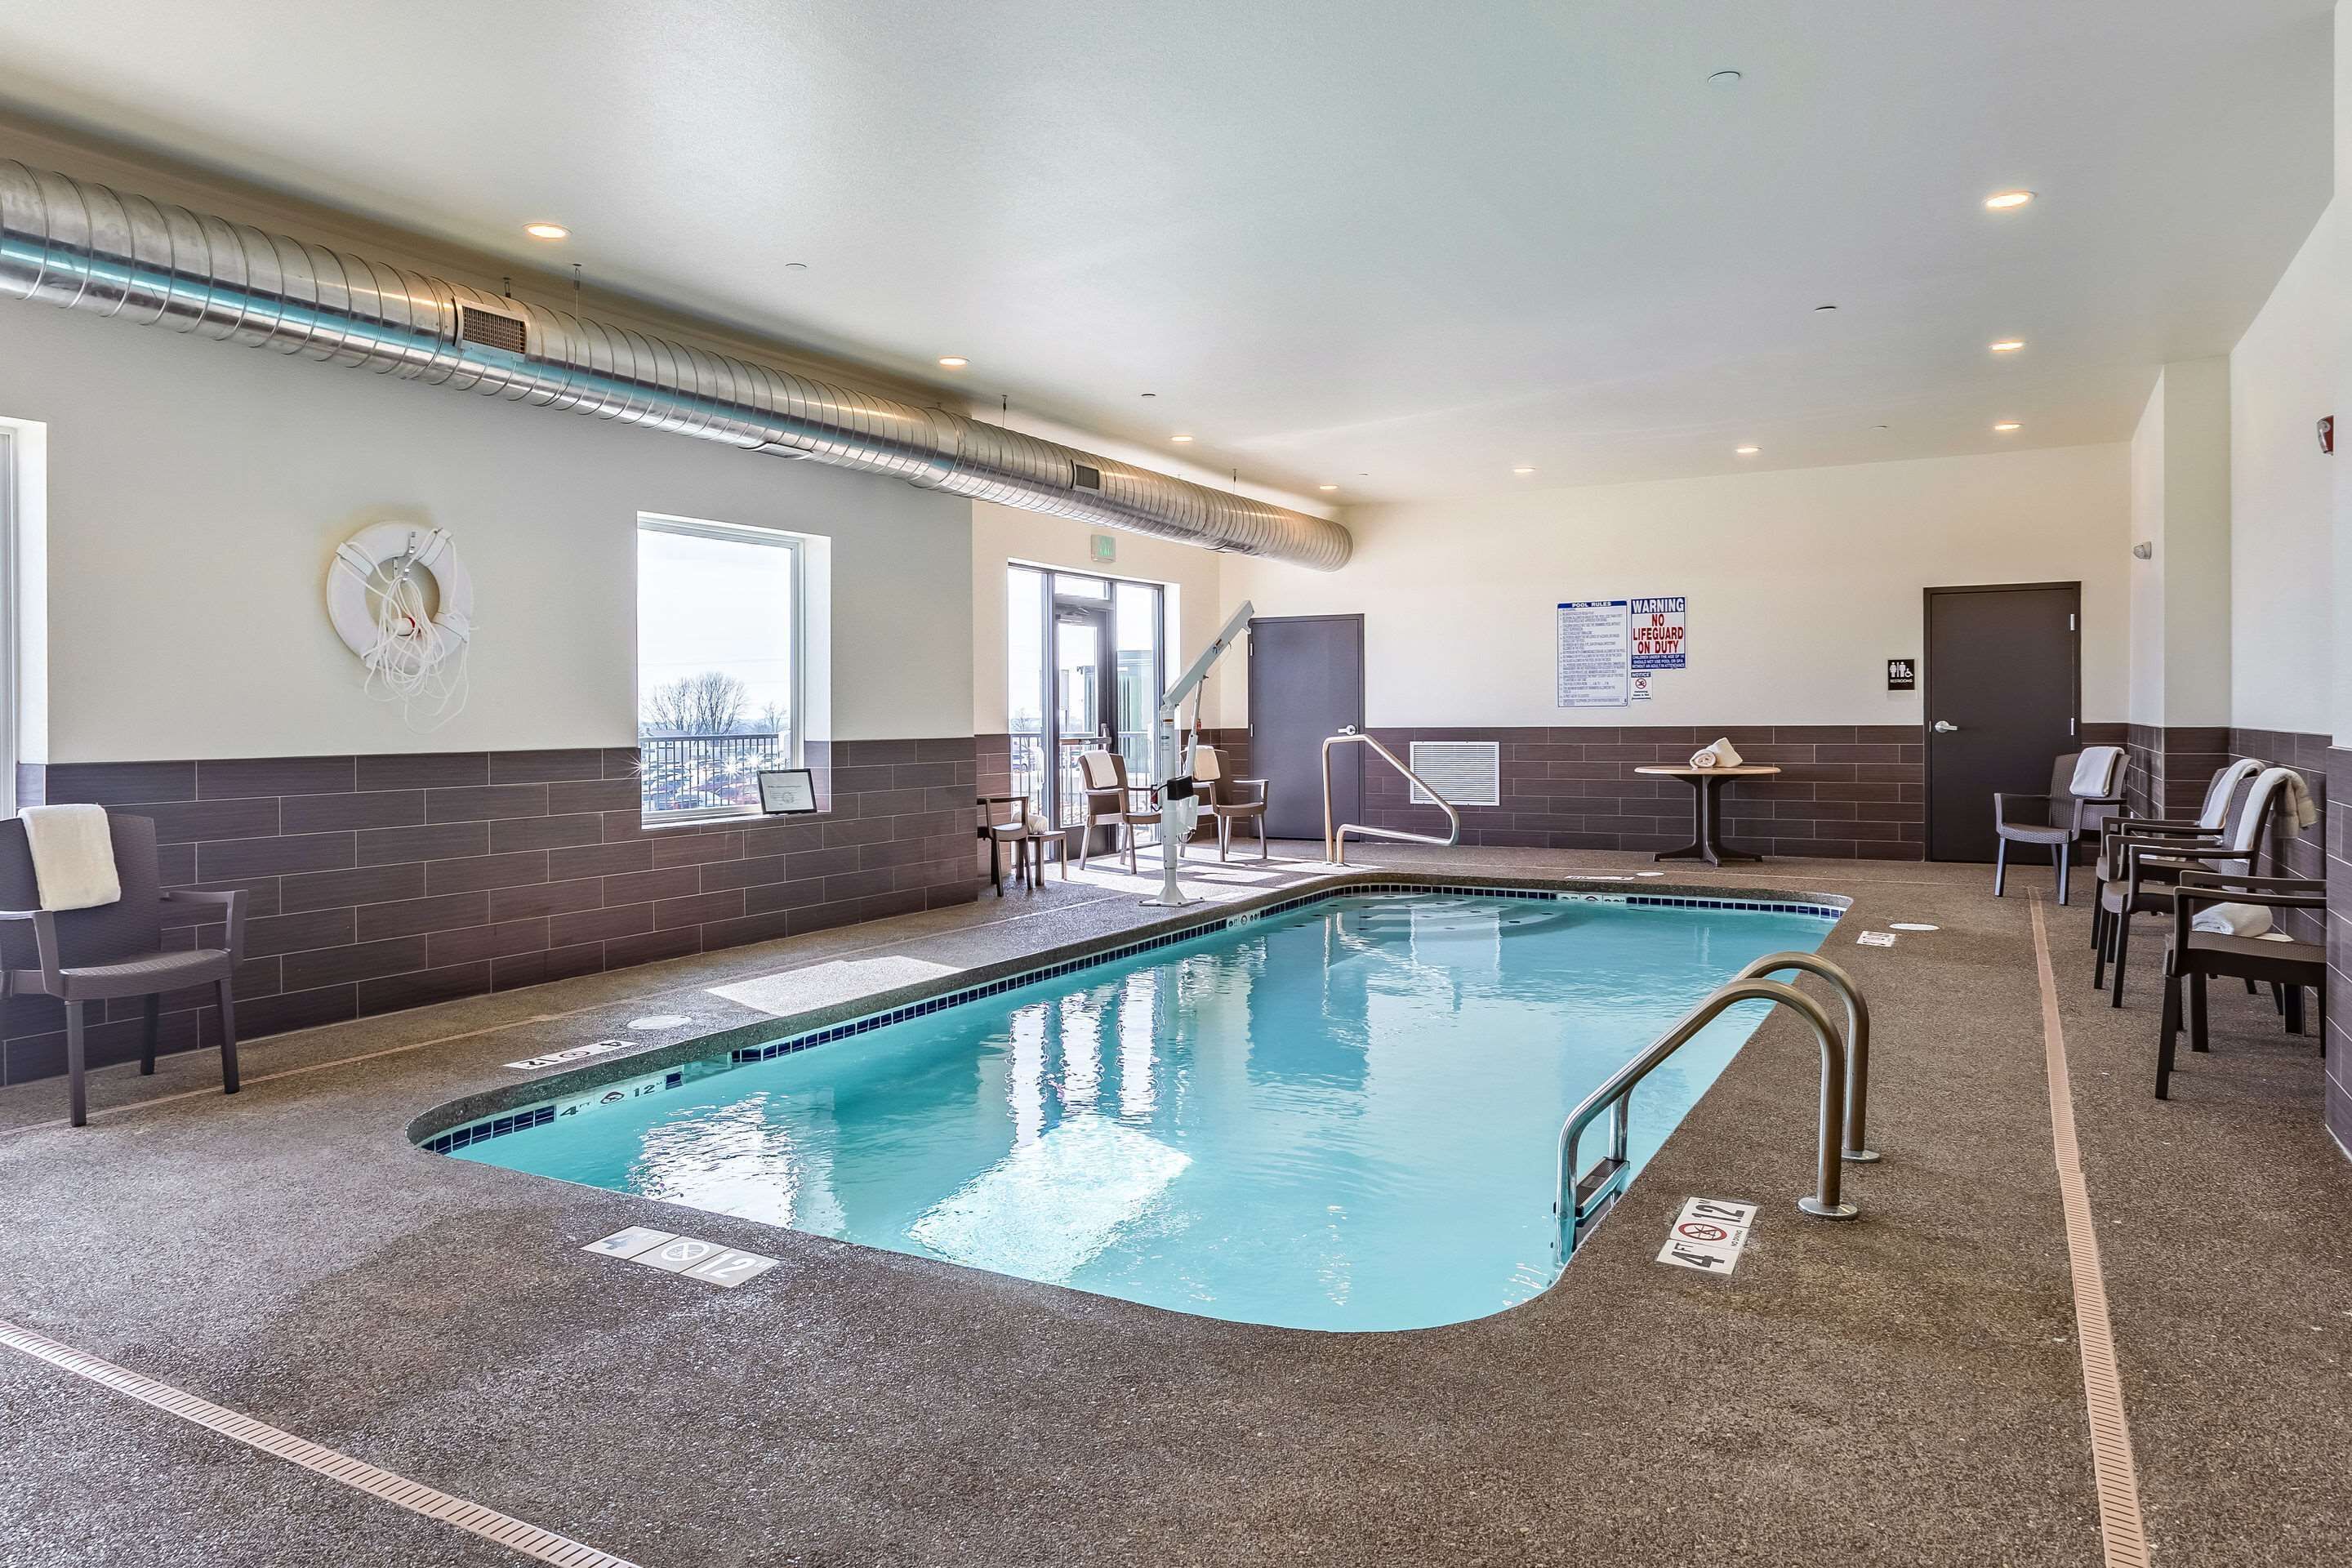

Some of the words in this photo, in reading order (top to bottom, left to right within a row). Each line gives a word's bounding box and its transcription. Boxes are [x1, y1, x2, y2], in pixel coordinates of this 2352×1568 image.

[1633, 598, 1684, 612] WARNING
[1651, 613, 1664, 626] NO
[1633, 626, 1684, 640] LIFEGUARD
[1637, 641, 1650, 654] ON
[1655, 640, 1679, 654] DUTY
[1673, 1242, 1694, 1253] FT
[1671, 1250, 1726, 1268] 4
